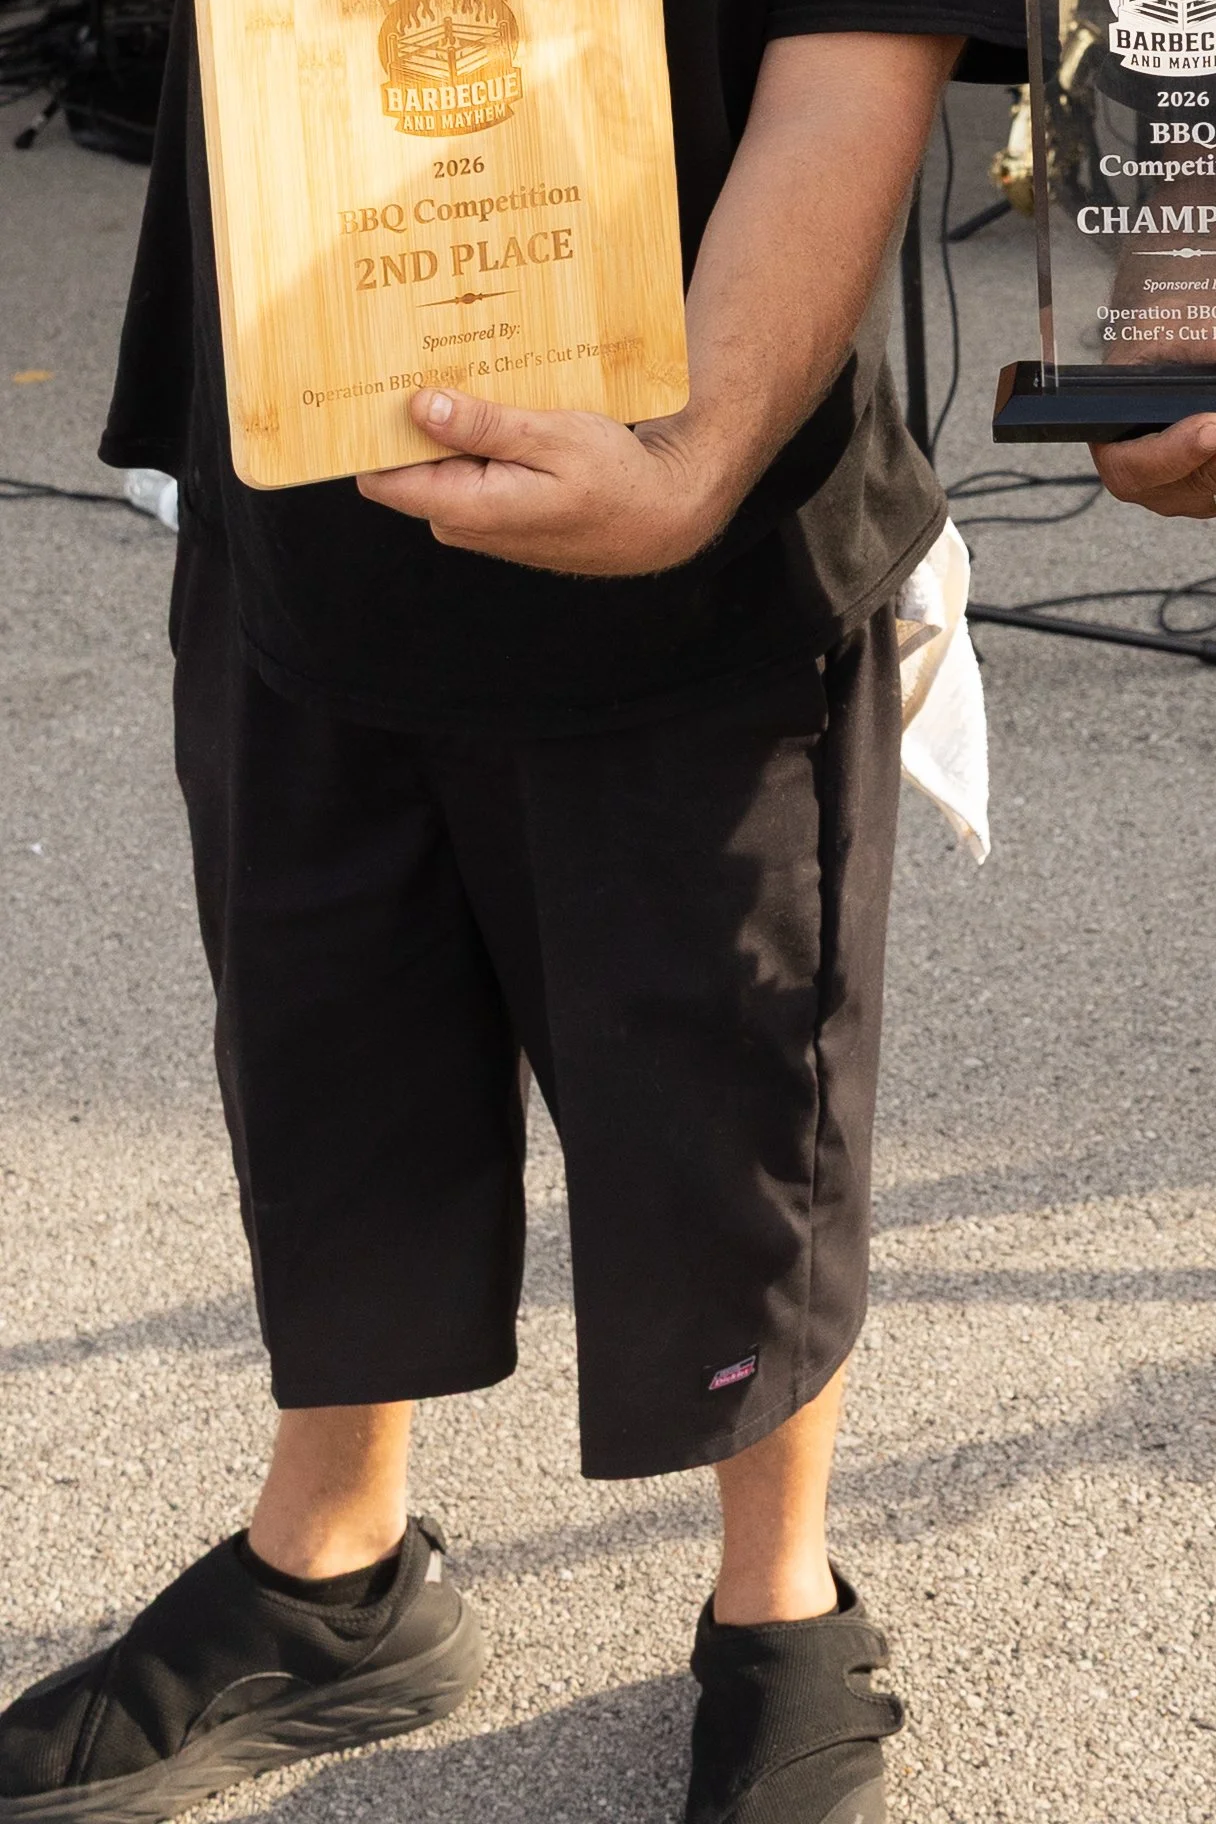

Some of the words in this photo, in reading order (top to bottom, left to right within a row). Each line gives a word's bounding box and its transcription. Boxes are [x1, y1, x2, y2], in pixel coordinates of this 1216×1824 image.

[1130, 53, 1161, 69] AND
[386, 72, 520, 112] BARBECUE
[1157, 91, 1210, 107] 2026
[403, 114, 435, 131] AND
[442, 104, 506, 130] MAYHEM
[433, 156, 485, 179] 2026
[338, 203, 407, 236] BBQ
[413, 182, 582, 223] Competition
[354, 249, 438, 292] 2ND
[450, 228, 574, 277] PLACE
[1143, 278, 1209, 293] Sponsored
[1096, 305, 1182, 323] Operation
[422, 324, 495, 352] Sponsored
[499, 322, 521, 339] By:
[1103, 327, 1117, 341] &
[1121, 326, 1174, 341] Chef's
[1179, 326, 1209, 340] Cut
[302, 380, 385, 407] Operation
[389, 371, 425, 391] BBQ
[477, 360, 491, 376] &
[494, 352, 543, 373] Chef's
[546, 348, 573, 364] Cut
